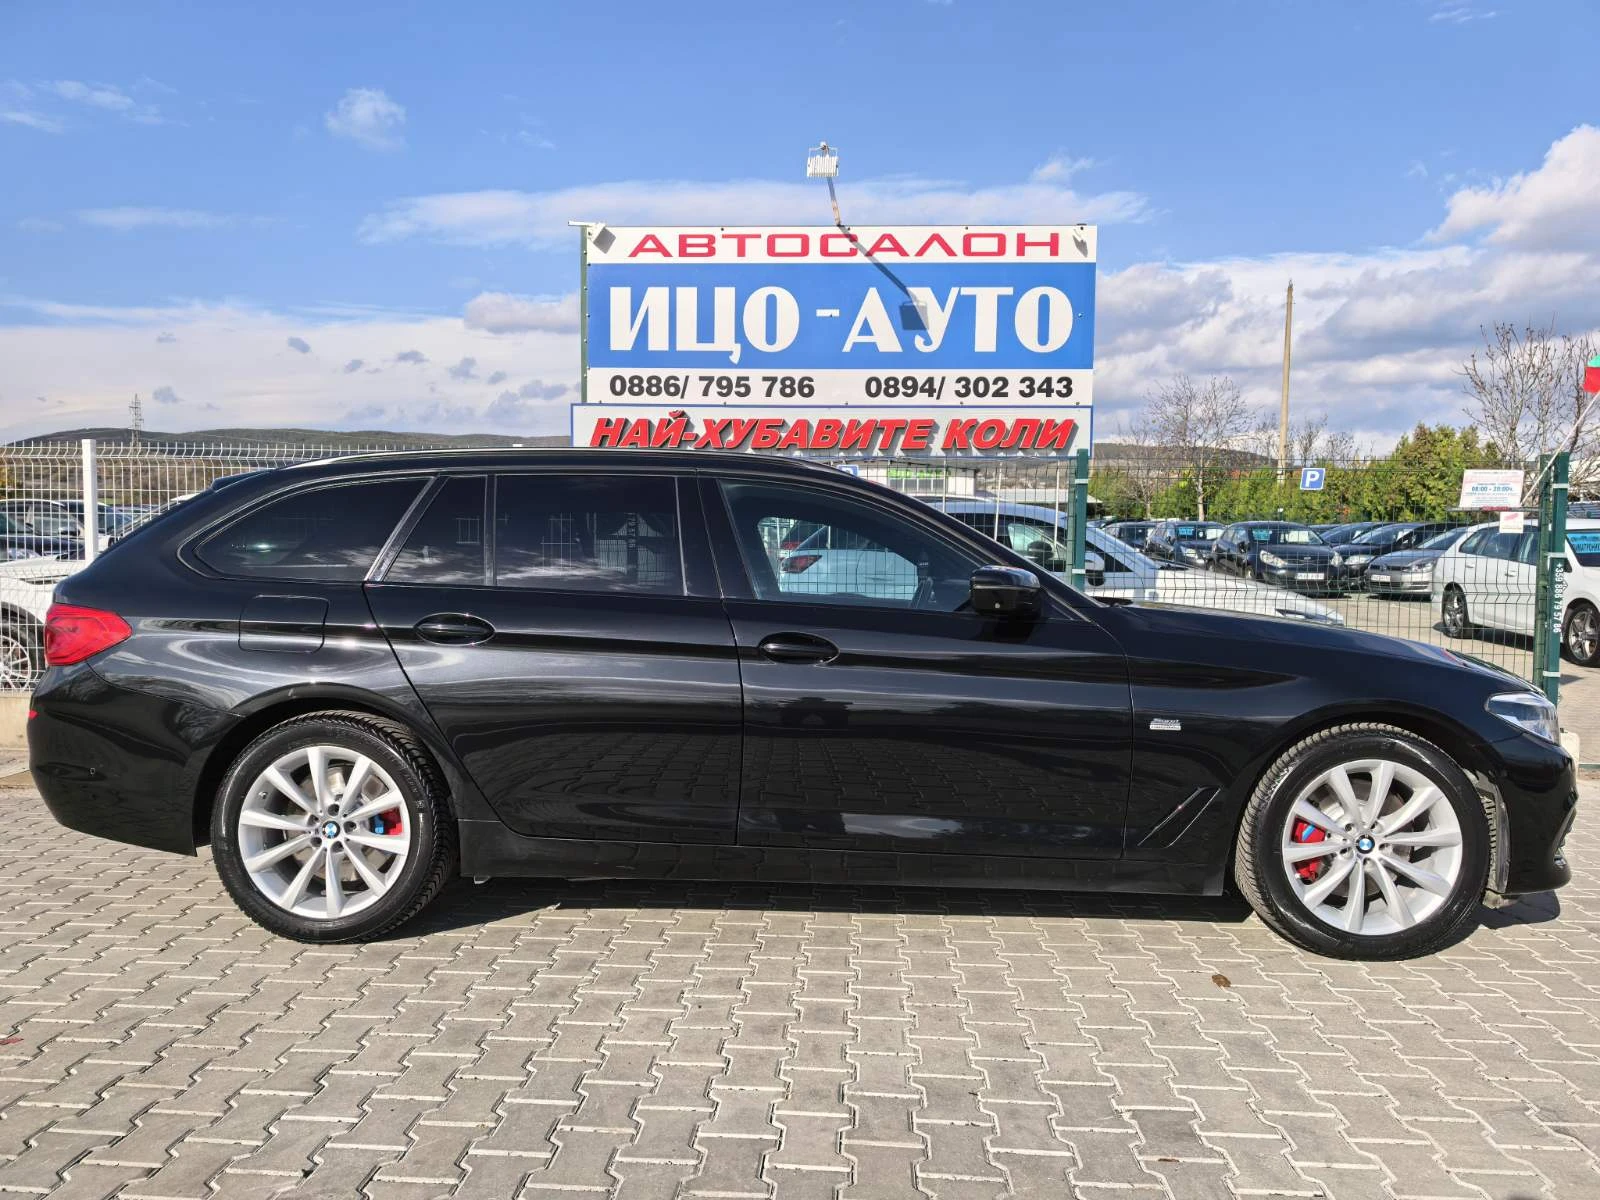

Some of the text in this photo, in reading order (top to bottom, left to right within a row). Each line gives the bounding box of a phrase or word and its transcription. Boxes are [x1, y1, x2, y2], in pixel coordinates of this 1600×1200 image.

[630, 233, 1060, 258] АВТОСАЛОН
[610, 286, 800, 364] ИЦО
[609, 374, 815, 399] 0886/ 795 786
[865, 376, 1073, 400] 0894/ 302 343
[590, 410, 1075, 449] НАЙ-ХУБАВИТЕ КОЛИ
[1305, 470, 1320, 488] P
